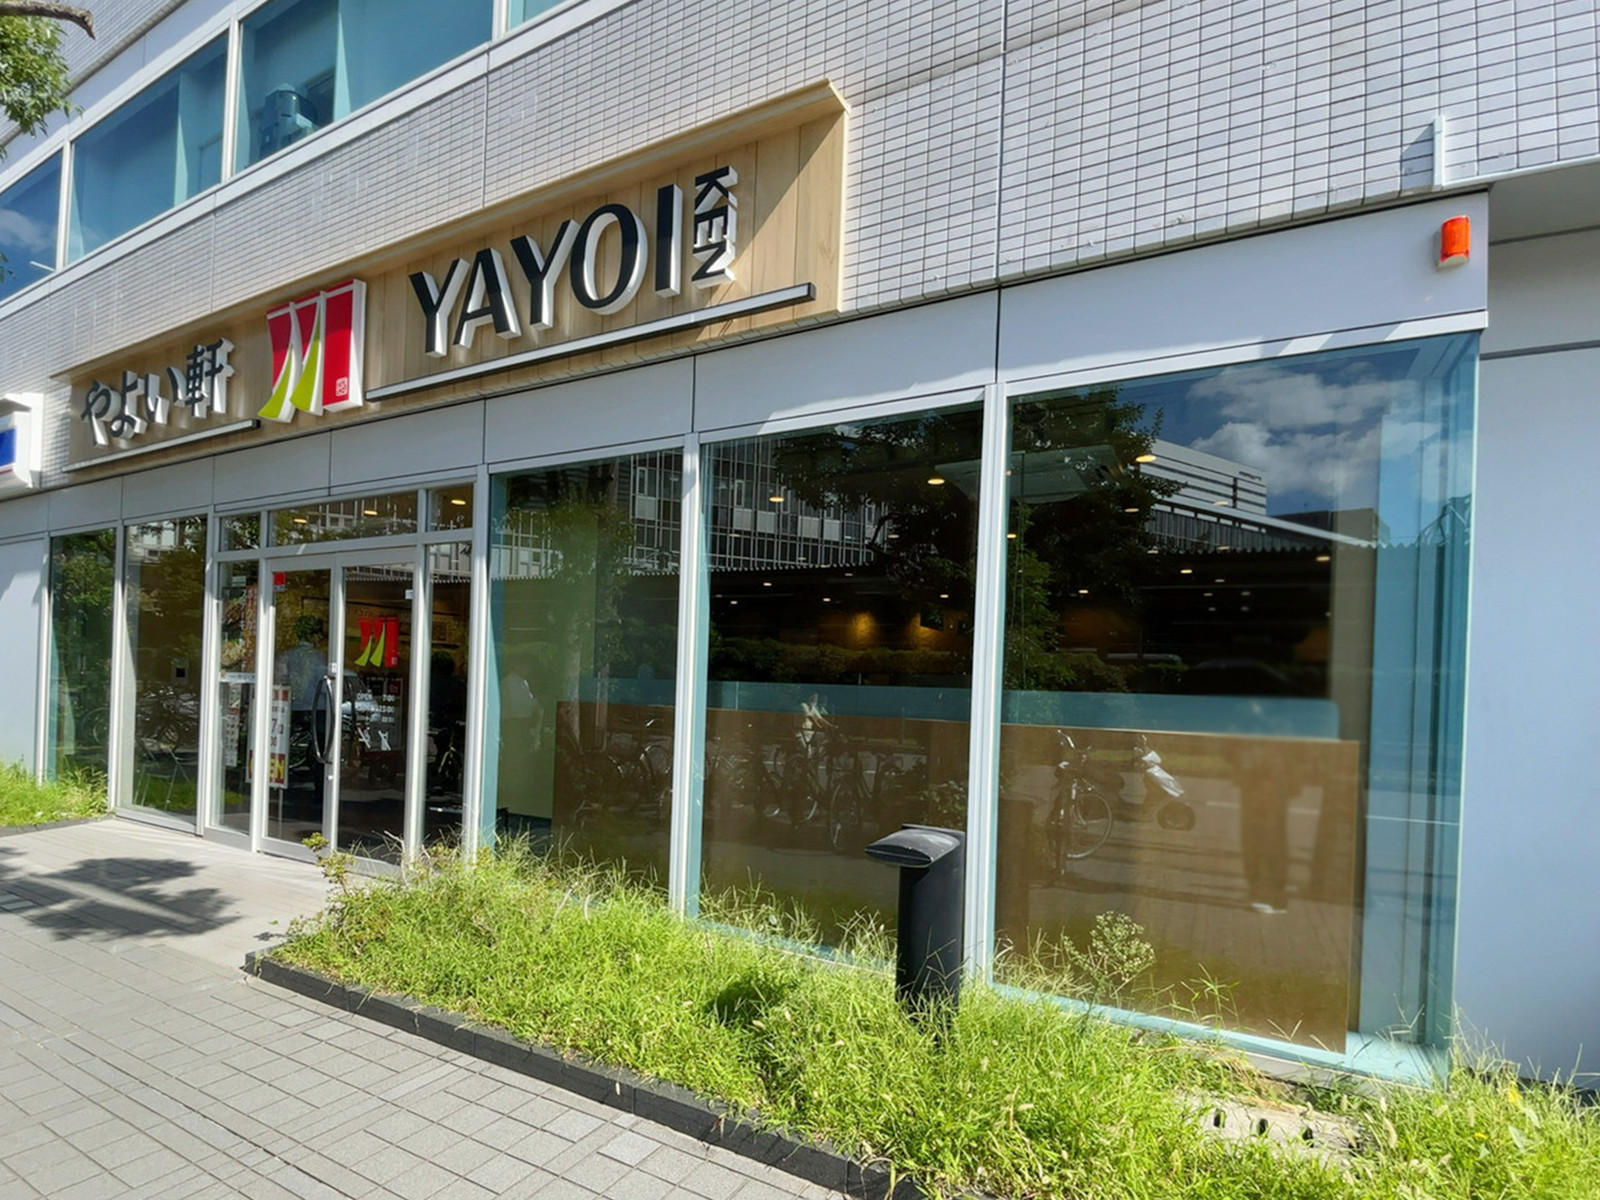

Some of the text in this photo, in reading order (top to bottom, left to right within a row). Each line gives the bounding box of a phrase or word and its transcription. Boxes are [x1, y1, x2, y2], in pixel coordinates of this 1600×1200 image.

[409, 165, 738, 358] YAYOI KEN
[81, 337, 234, 447] やよい軒
